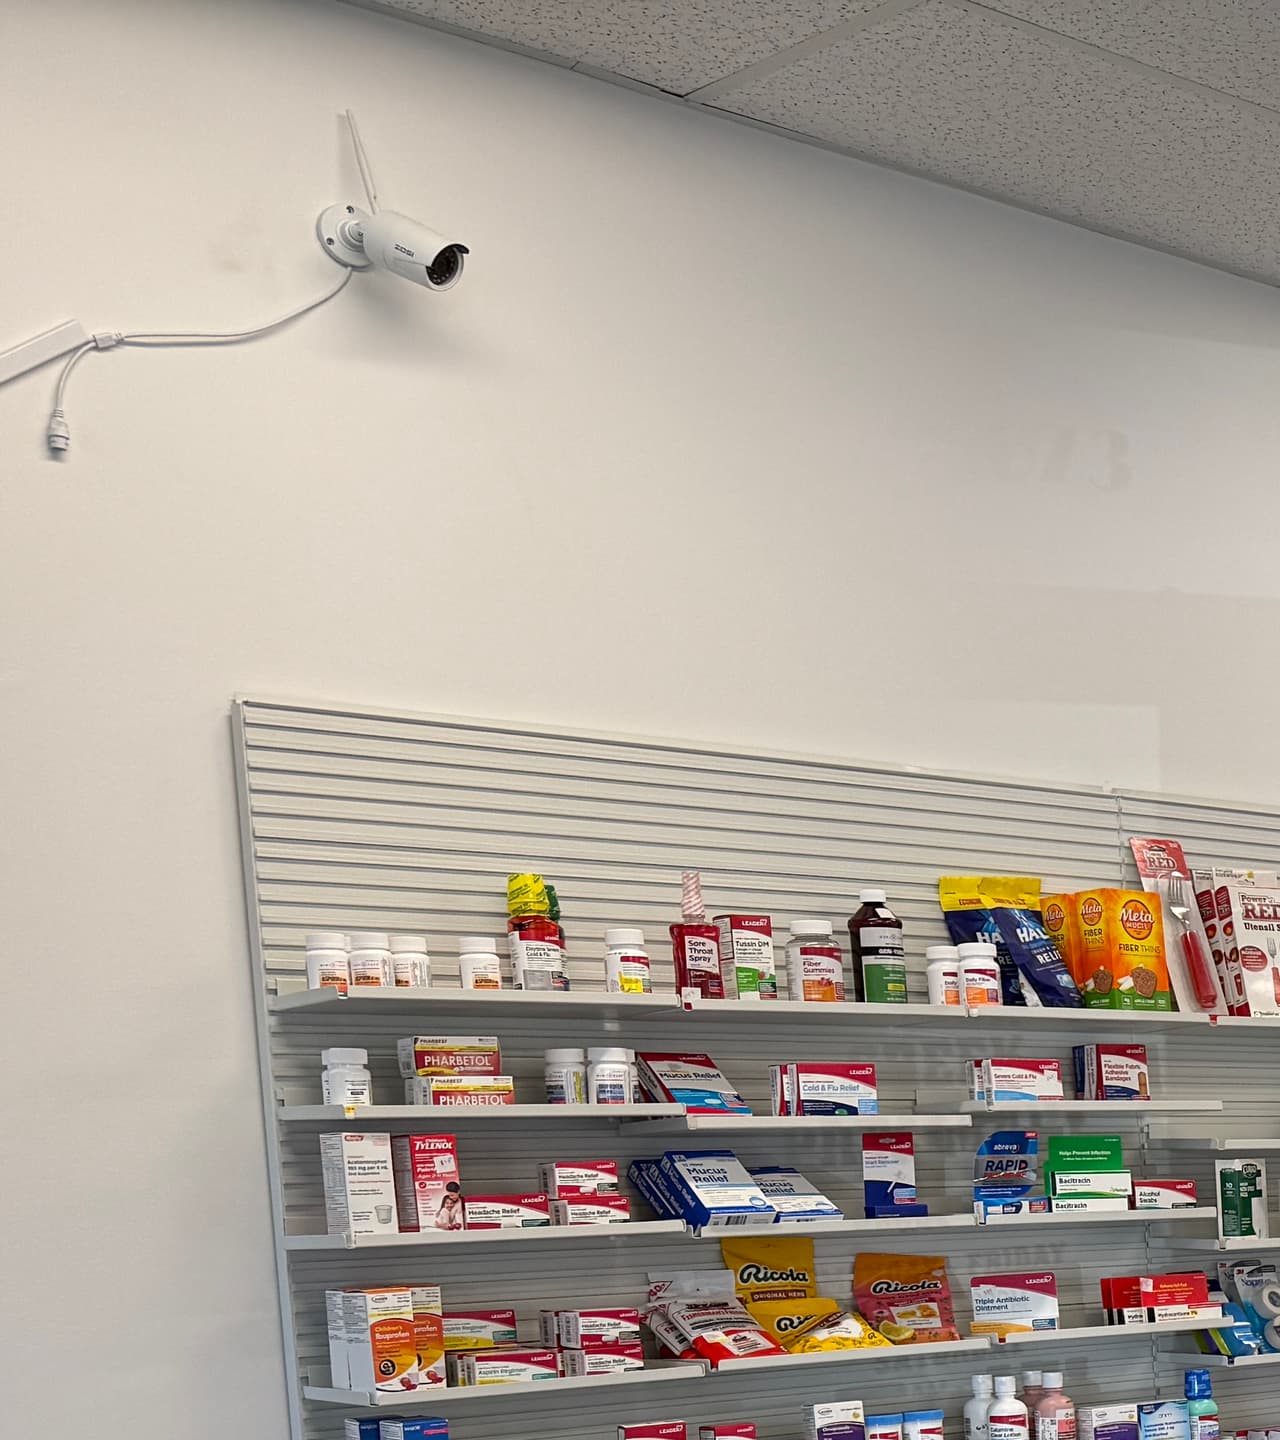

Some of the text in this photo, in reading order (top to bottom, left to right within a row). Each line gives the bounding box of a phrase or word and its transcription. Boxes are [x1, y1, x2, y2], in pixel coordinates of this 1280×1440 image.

[1147, 856, 1175, 869] RED
[1241, 895, 1266, 904] Power
[1080, 904, 1102, 914] Meta
[1120, 908, 1154, 924] Meta
[1244, 922, 1274, 931] Utensil
[1084, 929, 1102, 937] FIBER
[757, 940, 769, 948] DM
[689, 947, 713, 955] Throat
[1119, 944, 1160, 954] FIBER THINS
[689, 954, 711, 964] Spray
[424, 1055, 492, 1067] PHARBETOL
[659, 1072, 722, 1080] Mucus Relief
[802, 1084, 818, 1092] Cold
[839, 1084, 860, 1092] Relief
[439, 1094, 505, 1104] PHARBETOL
[414, 1141, 452, 1150] TYLENOL
[993, 1144, 1017, 1152] abreva
[985, 1159, 1028, 1172] RAPID
[687, 1167, 727, 1176] Mucus
[692, 1174, 729, 1184] Relief
[1058, 1177, 1091, 1185] Bacitracin
[1139, 1190, 1160, 1198] Alcohol
[738, 1264, 809, 1285] Ricola
[871, 1281, 942, 1294] Ricola
[752, 1292, 785, 1300] ORIGINAL
[975, 1296, 1030, 1305] Triple Antibiotic
[975, 1303, 1009, 1311] Ointment
[375, 1331, 410, 1340] Ibuprofen
